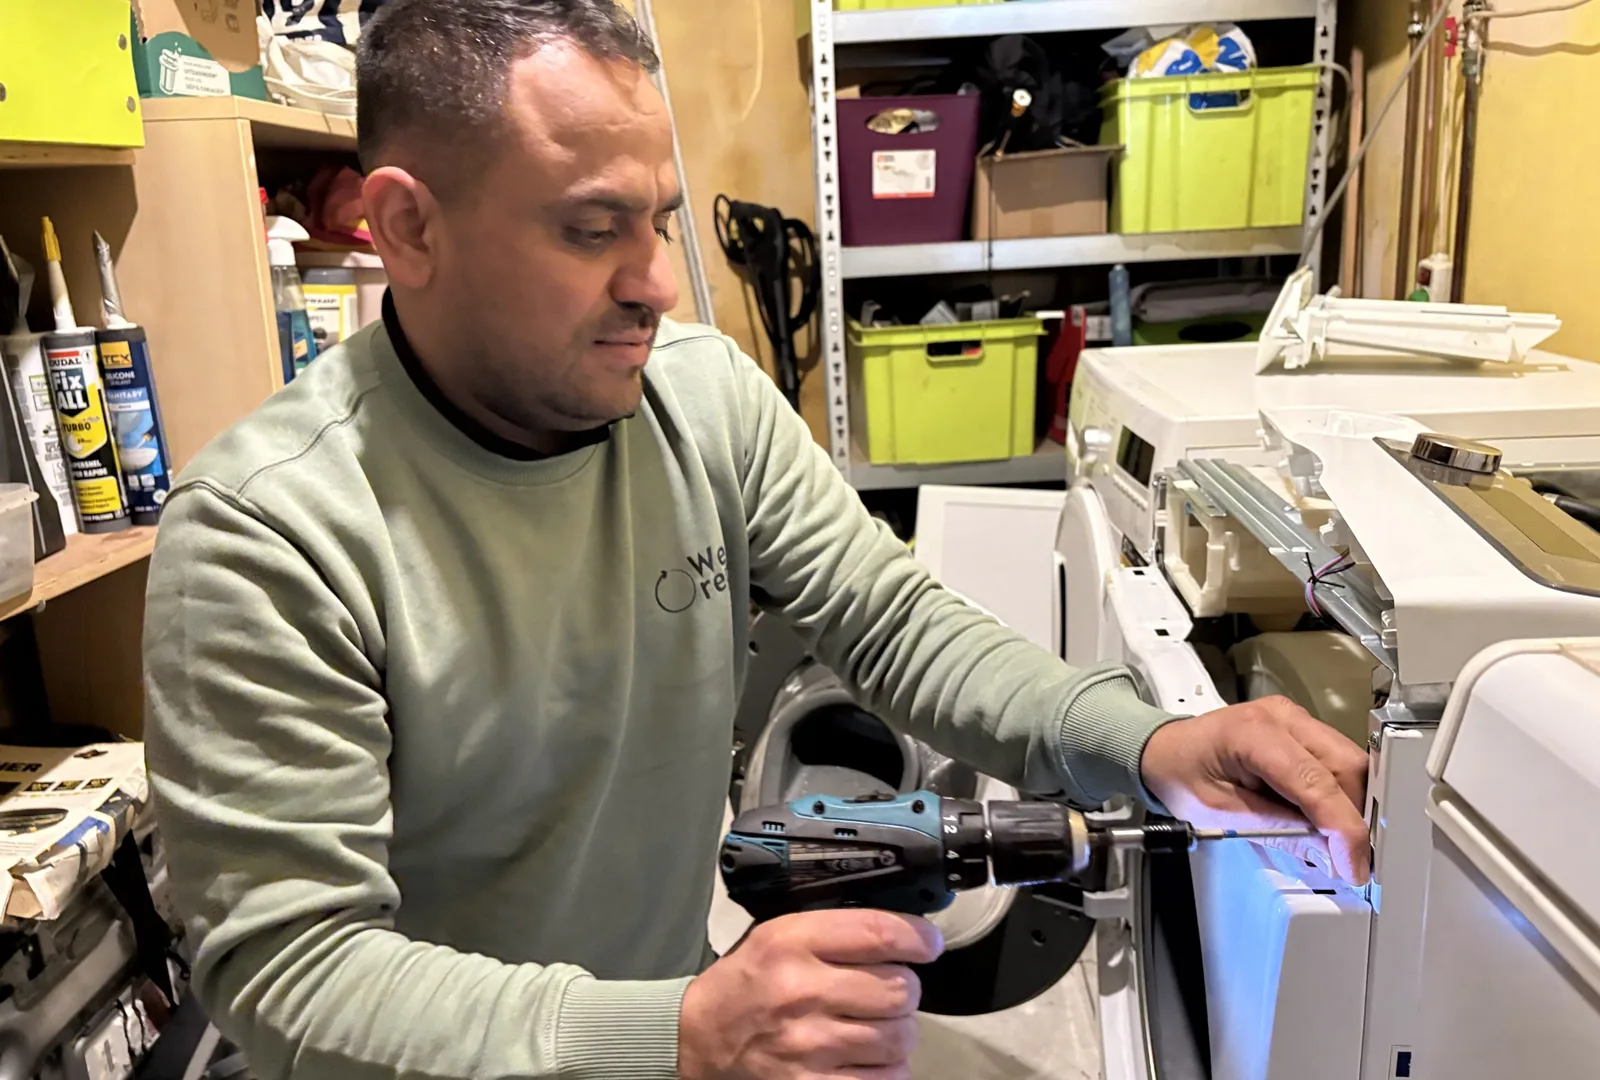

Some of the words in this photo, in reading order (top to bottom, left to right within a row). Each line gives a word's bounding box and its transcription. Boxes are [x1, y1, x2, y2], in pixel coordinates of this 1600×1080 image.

[50, 358, 81, 367] OUDAL
[52, 371, 83, 390] Fix
[58, 390, 87, 410] ALL
[63, 422, 91, 432] TURBO
[686, 546, 726, 577] We
